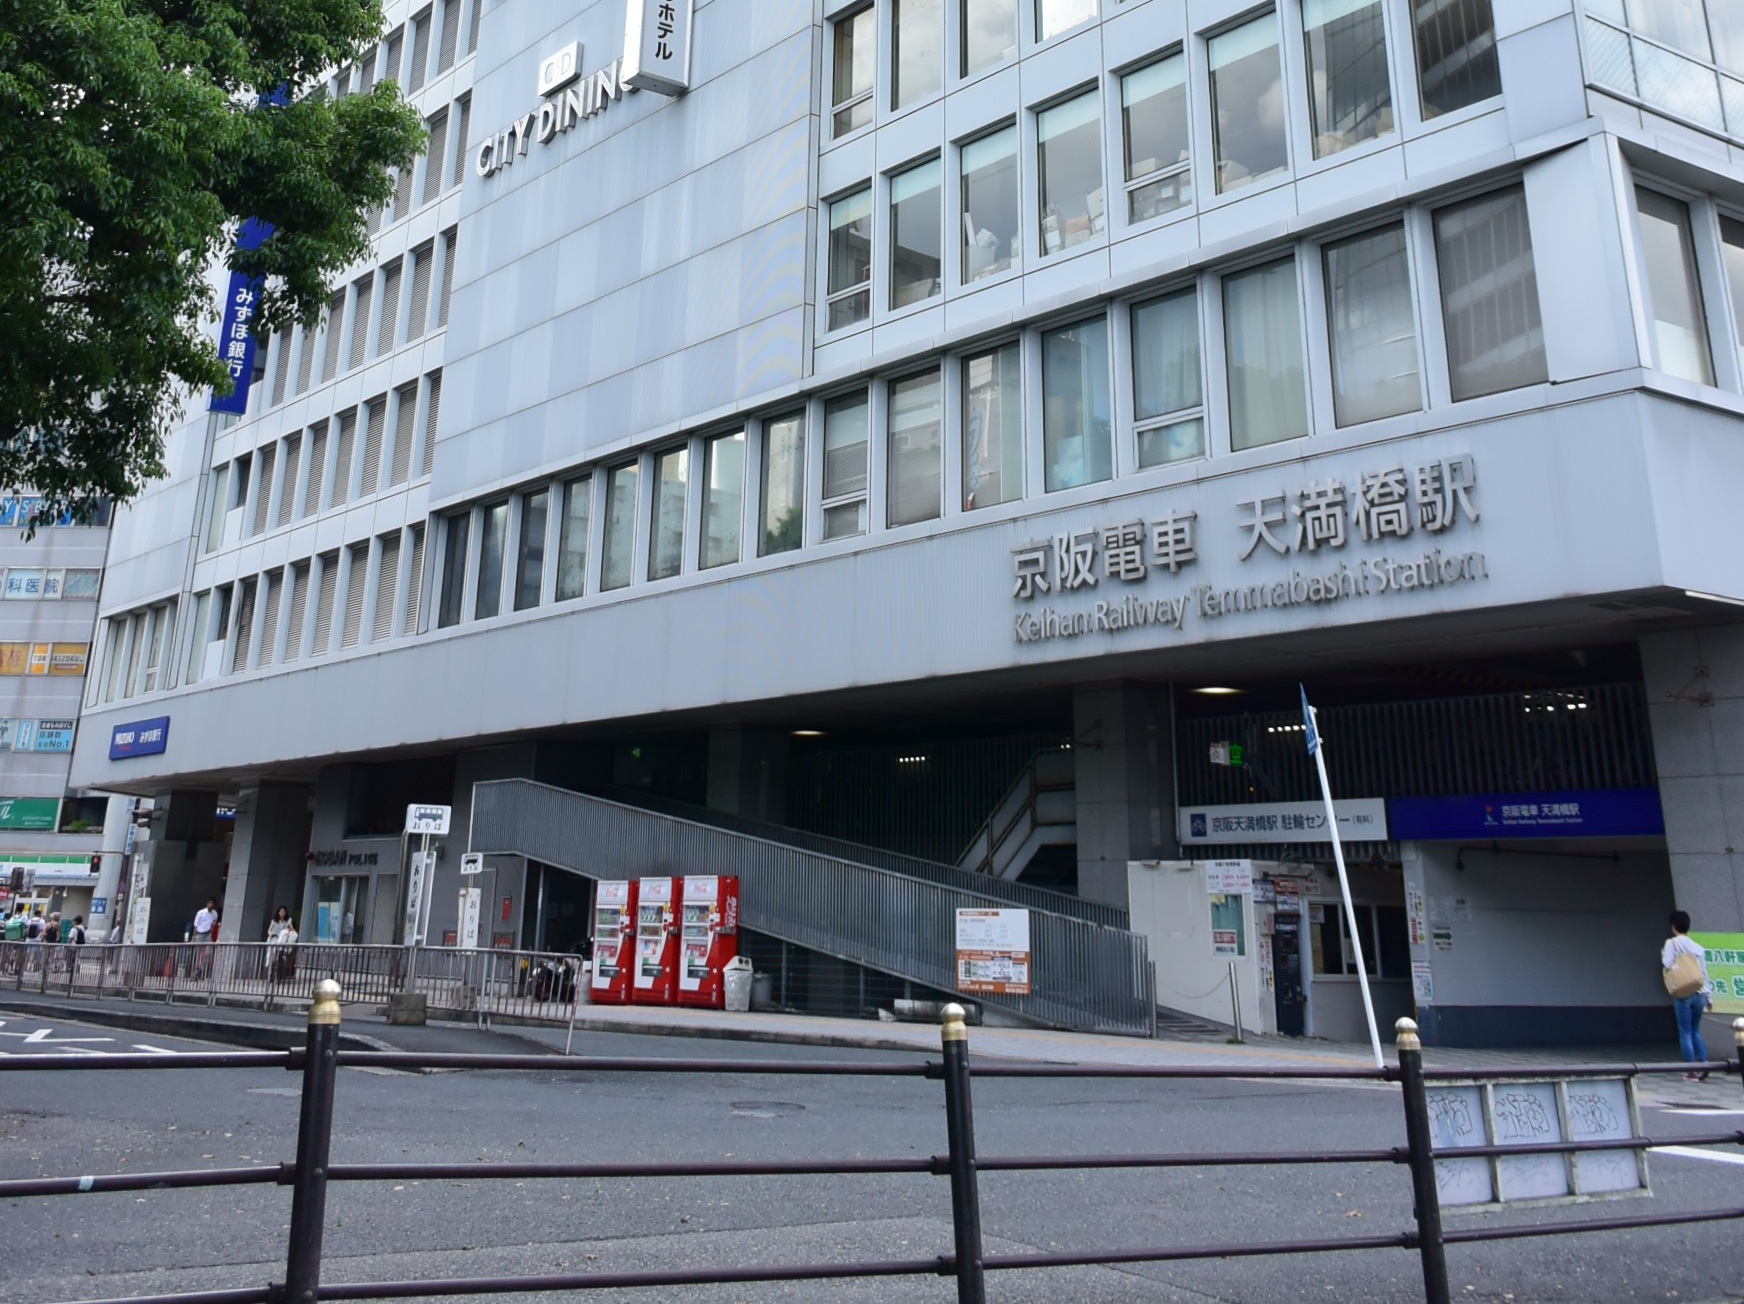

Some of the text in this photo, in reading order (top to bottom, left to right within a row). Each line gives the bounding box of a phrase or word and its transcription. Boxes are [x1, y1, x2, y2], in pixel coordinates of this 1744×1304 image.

[475, 112, 536, 179] CITY
[226, 287, 254, 378] みずほ銀行
[1012, 452, 1481, 598] 京阪電車 天満橋駅
[0, 577, 59, 594] 科医院
[1013, 547, 1488, 643] Keihan Railway Temmabashi Station
[115, 731, 135, 745] MIZUHO
[1211, 816, 1279, 833] 京阪天満橋駅
[1501, 802, 1581, 817] 京阪電車 天満橋駅
[466, 899, 478, 939] おりば
